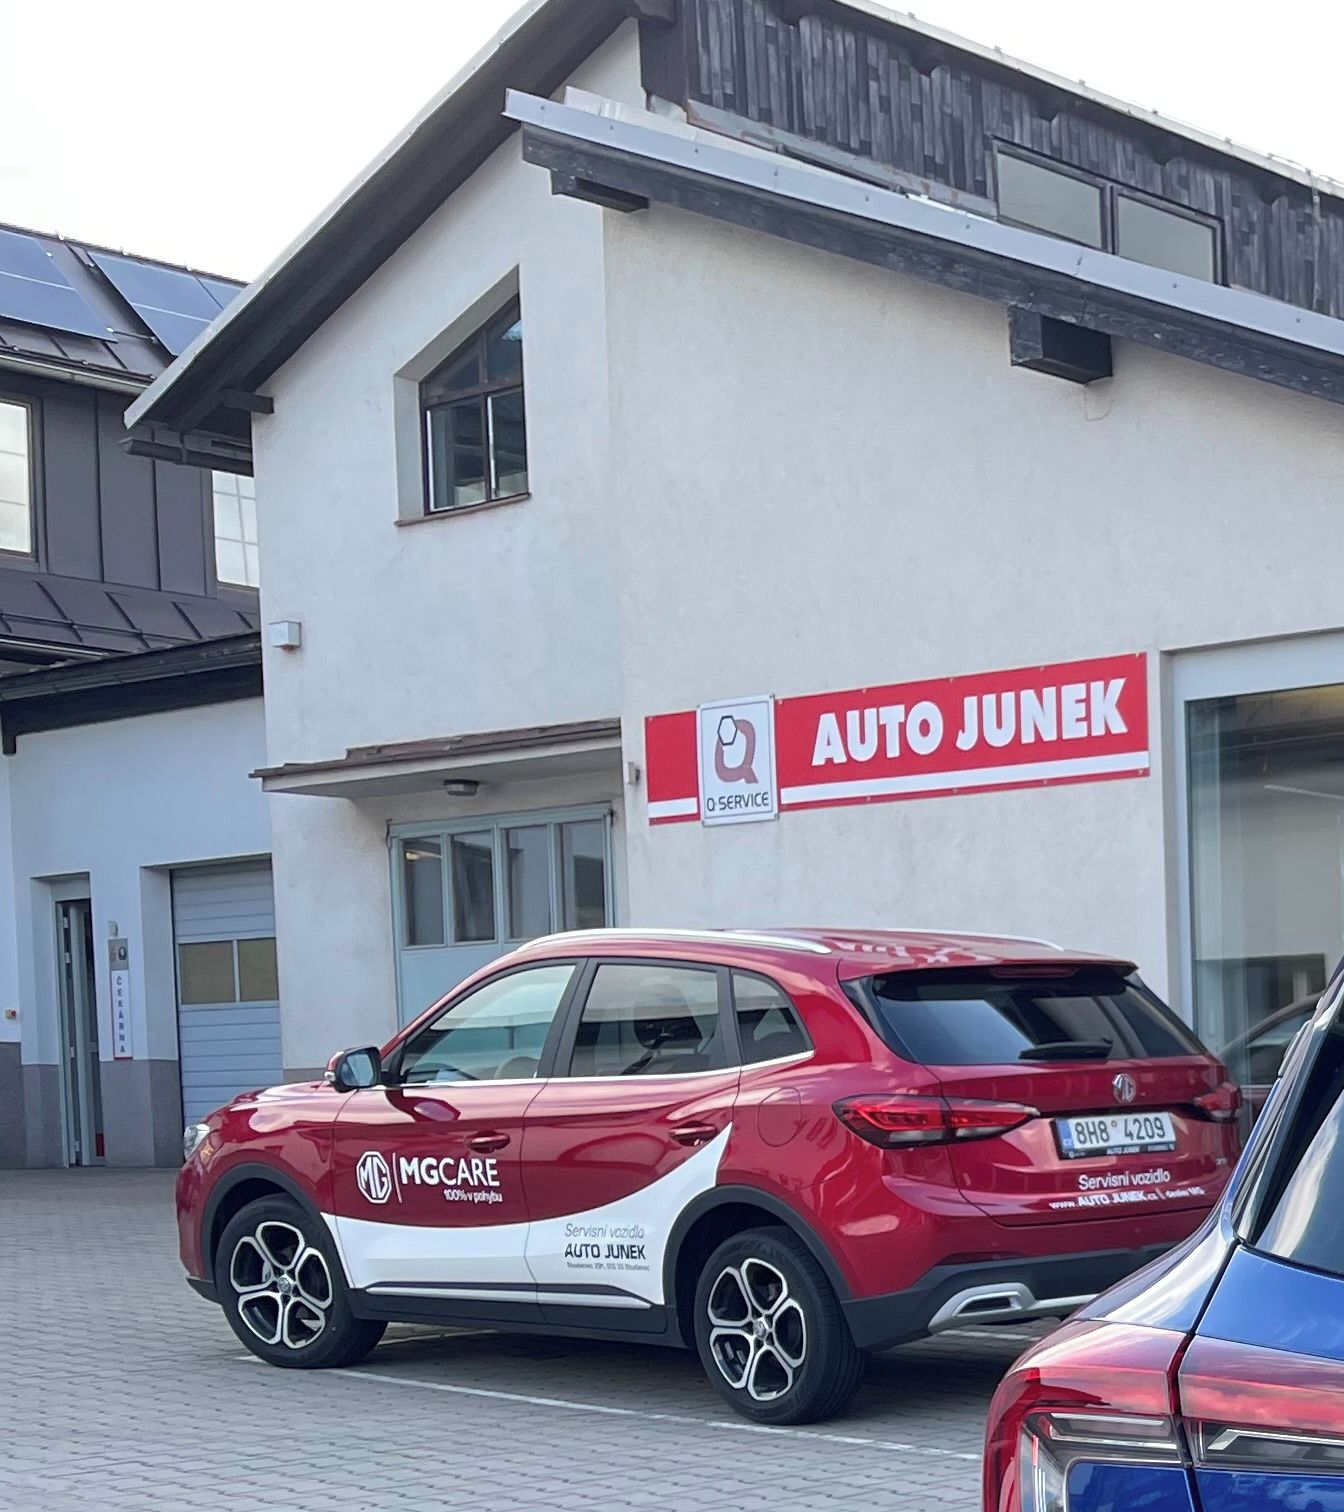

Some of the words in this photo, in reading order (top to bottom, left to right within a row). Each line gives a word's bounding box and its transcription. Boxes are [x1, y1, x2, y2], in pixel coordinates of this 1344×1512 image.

[810, 701, 944, 767] AUTO
[956, 678, 1128, 751] JUNEK
[1075, 1119, 1110, 1145] 8H8
[1124, 1117, 1166, 1141] 4209
[358, 1152, 390, 1203] MG
[400, 1157, 500, 1187] MGCARE
[1079, 1171, 1130, 1190] Servisní
[1131, 1168, 1170, 1185] vozidlo
[565, 1222, 608, 1238] Servisní
[609, 1223, 645, 1239] vozidlo
[564, 1242, 601, 1259] AUTO
[604, 1243, 647, 1260] JUNEK
